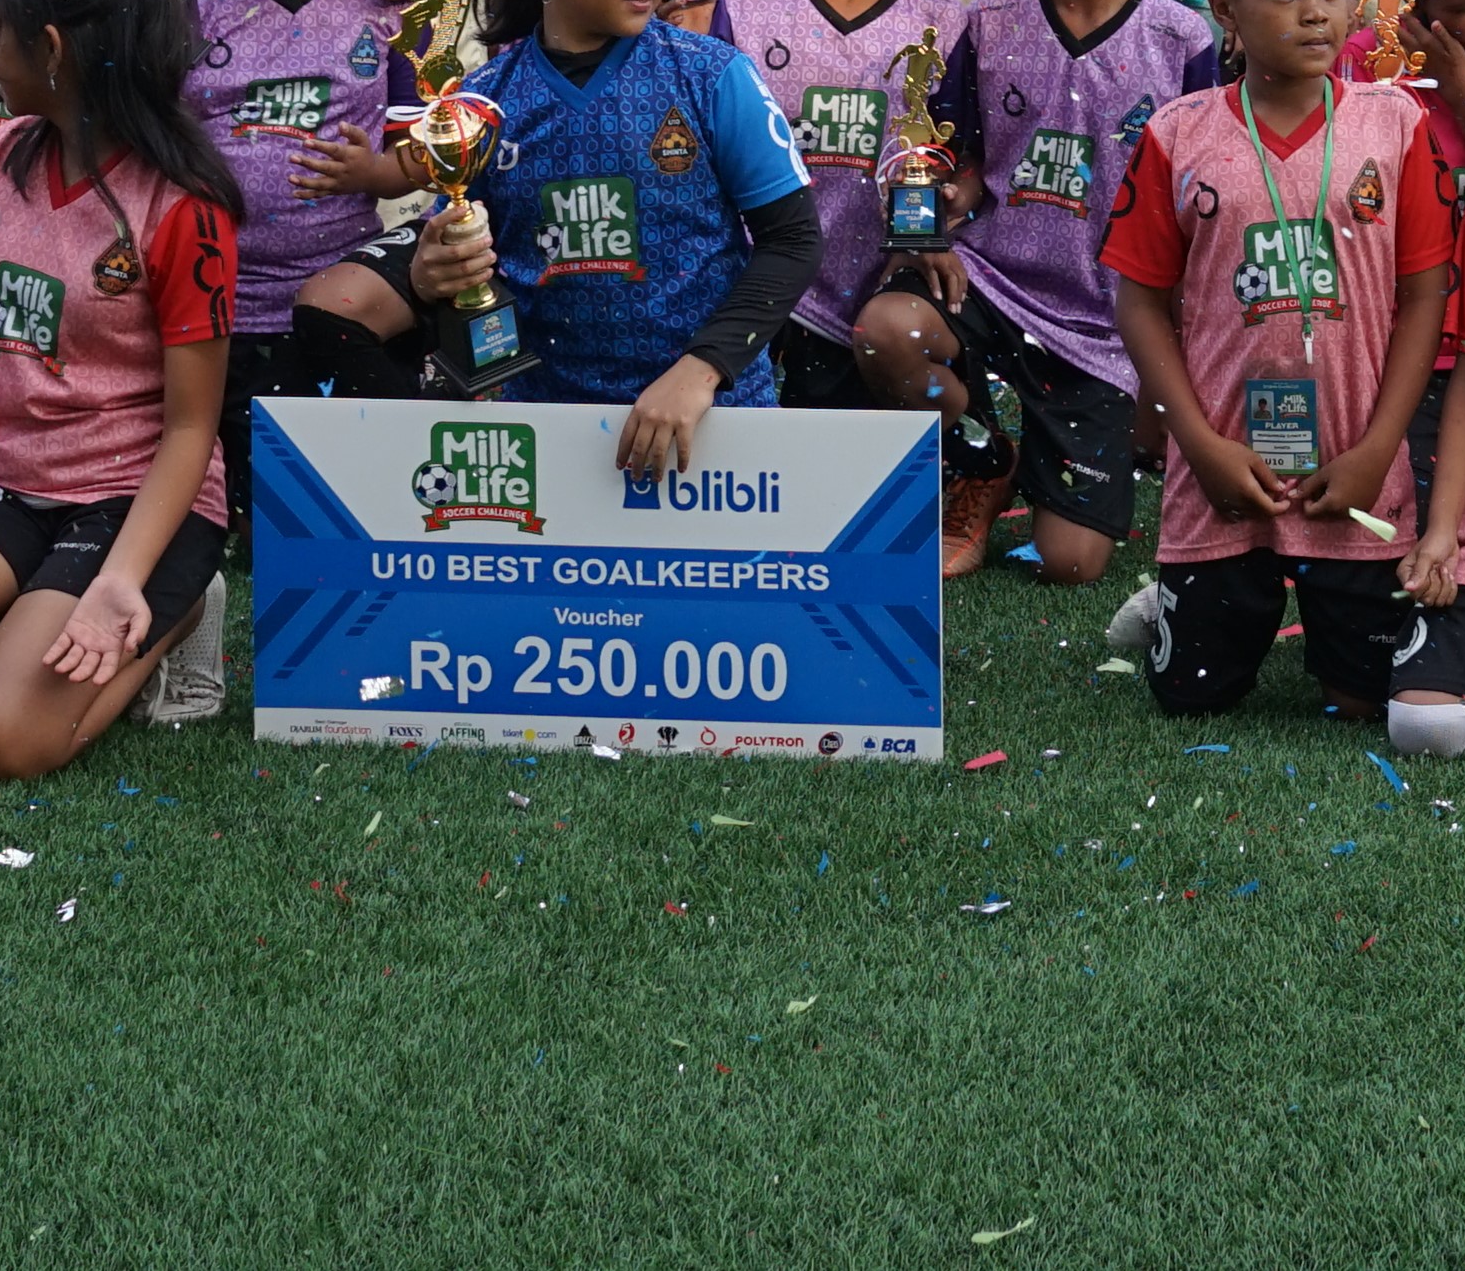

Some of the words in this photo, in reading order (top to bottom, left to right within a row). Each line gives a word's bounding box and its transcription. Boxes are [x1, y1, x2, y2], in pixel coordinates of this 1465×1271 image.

[256, 80, 320, 105] Milk
[262, 102, 317, 129] Life
[812, 93, 878, 126] Milk
[820, 123, 877, 154] Life
[662, 149, 689, 157] SHINTA
[806, 155, 834, 165] SOCCER
[835, 156, 871, 167] CHALLENGE
[1033, 135, 1085, 168] Milk
[1035, 163, 1084, 197] Life
[551, 184, 626, 222] Milk
[1022, 190, 1045, 201] SOCCER
[1045, 193, 1082, 209] CHALLENGE
[563, 220, 633, 258] Life
[549, 262, 581, 275] SOCCER
[582, 260, 630, 272] CHALLENGE
[0, 271, 53, 320] Milk
[1257, 300, 1288, 314] SOCCER
[4, 305, 53, 351] Life
[1284, 394, 1306, 406] Milk
[1287, 402, 1308, 414] Life
[1265, 422, 1299, 430] PLAYER
[443, 429, 525, 469] Milk
[1265, 457, 1284, 466] U10
[457, 466, 529, 504] Life
[668, 470, 780, 513] blibli
[442, 508, 476, 520] SOCCER
[477, 507, 527, 521] CHALLENGE
[372, 553, 434, 580] U10
[447, 555, 542, 583] BEST
[553, 558, 830, 591] GOALKEEPERS
[554, 607, 643, 627] Voucher
[410, 640, 493, 704] Rp
[513, 636, 788, 701] 250.000
[324, 724, 372, 735] foundation
[736, 735, 799, 747] POLYTRON
[881, 737, 917, 753] BCA
